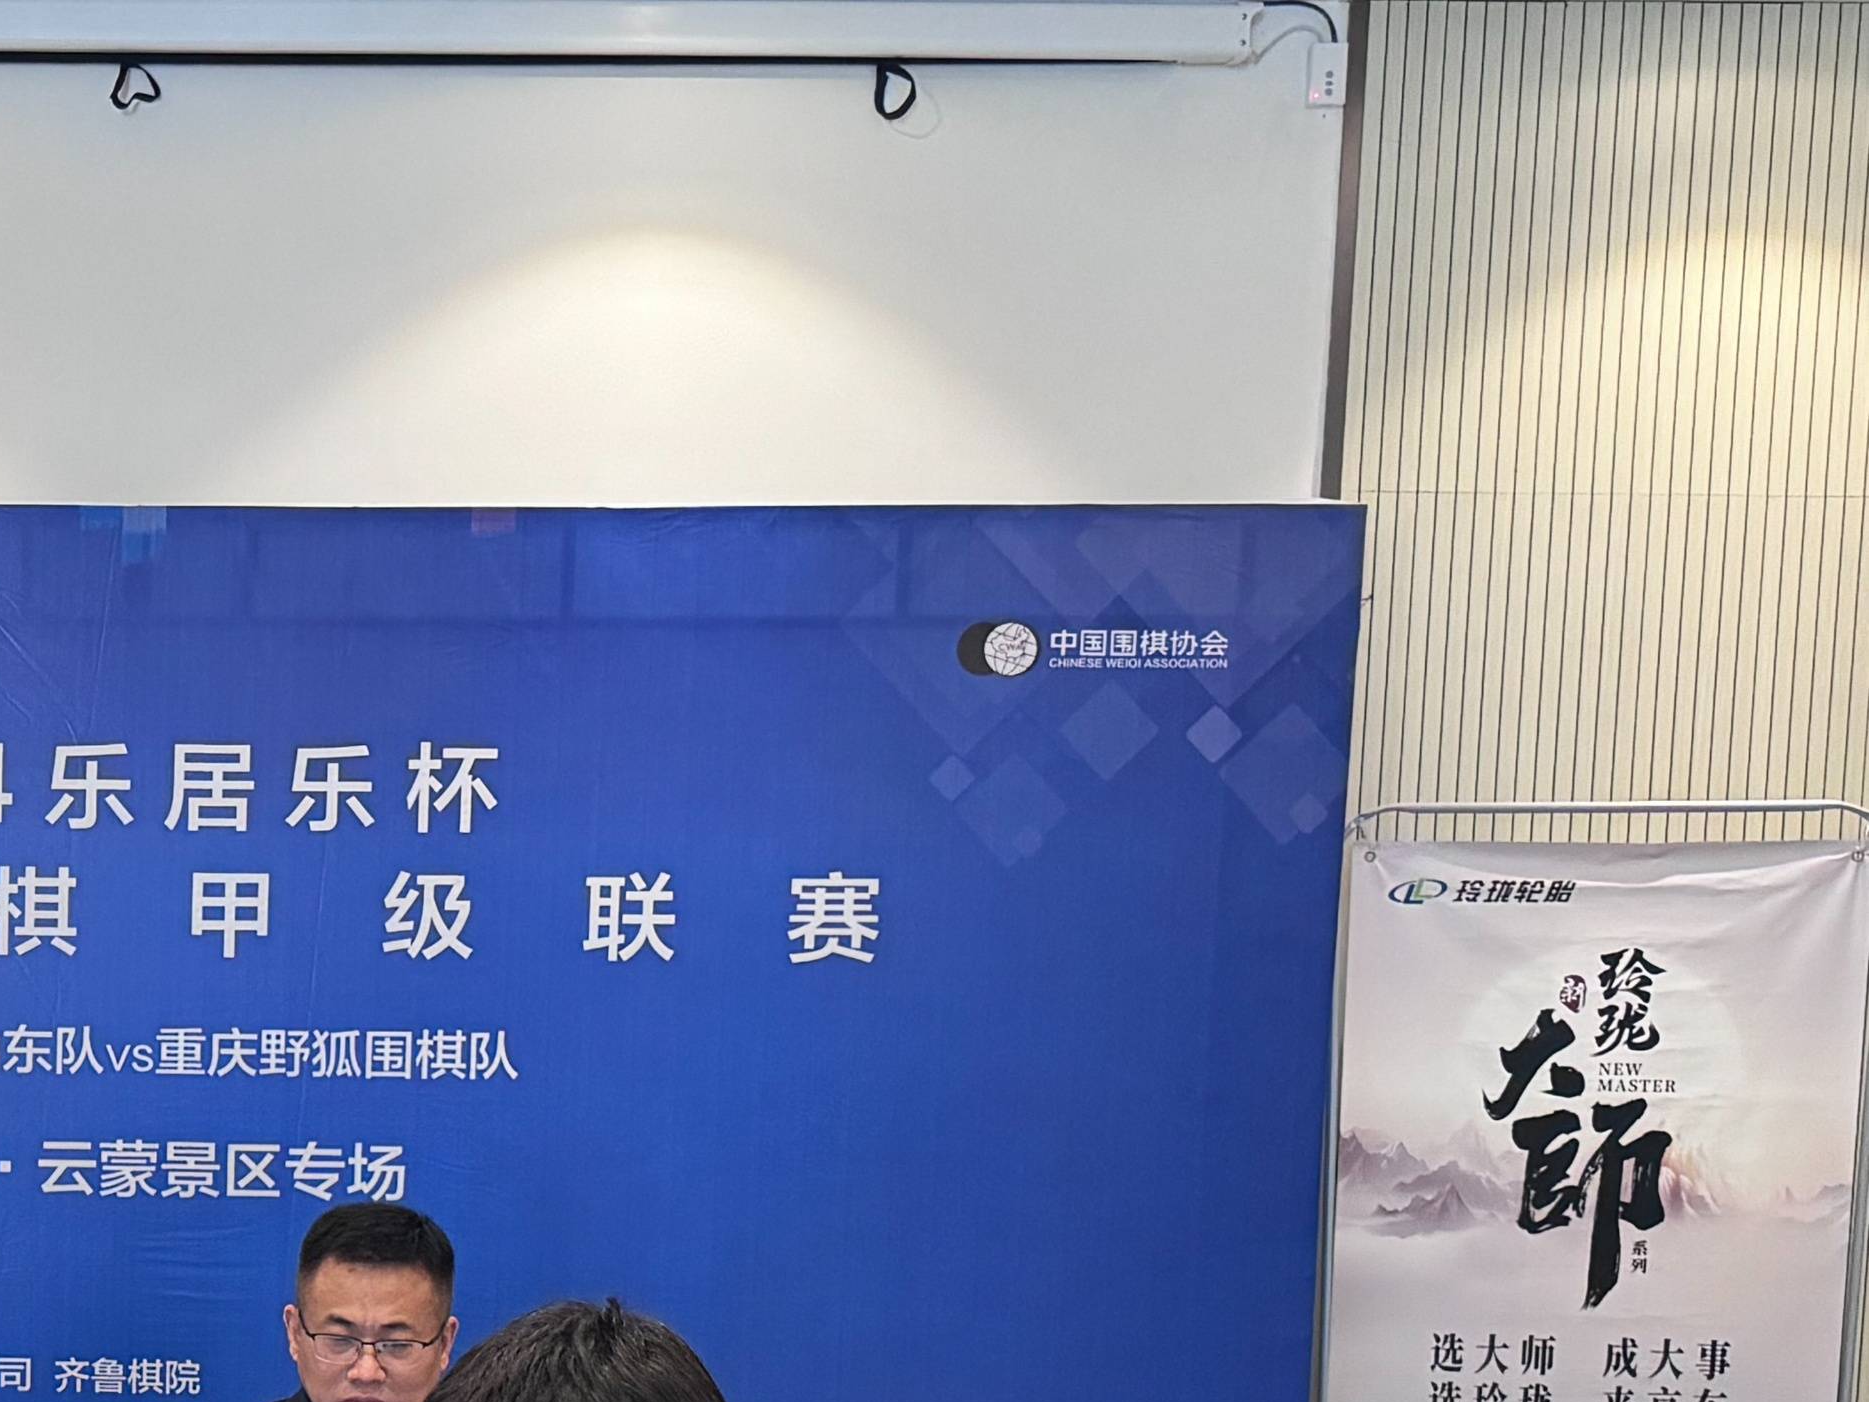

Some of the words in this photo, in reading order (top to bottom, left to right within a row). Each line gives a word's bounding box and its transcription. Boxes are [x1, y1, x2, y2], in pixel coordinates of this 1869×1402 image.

[1050, 629, 1229, 656] 中国围棋协会
[1049, 658, 1102, 668] CHINESE
[1144, 658, 1229, 669] ASSOCIATION
[45, 741, 500, 834] 乐居乐杯
[1452, 880, 1576, 903] 玲珑轮胎
[1590, 947, 1667, 1057] 玲珑
[1598, 1063, 1643, 1076] NEW
[1597, 1079, 1676, 1093] MASTER
[1630, 1239, 1648, 1275] 系列
[1431, 1333, 1557, 1376] 选大师
[1602, 1337, 1732, 1381] 成大事
[54, 1357, 201, 1395] 齐鲁棋院
